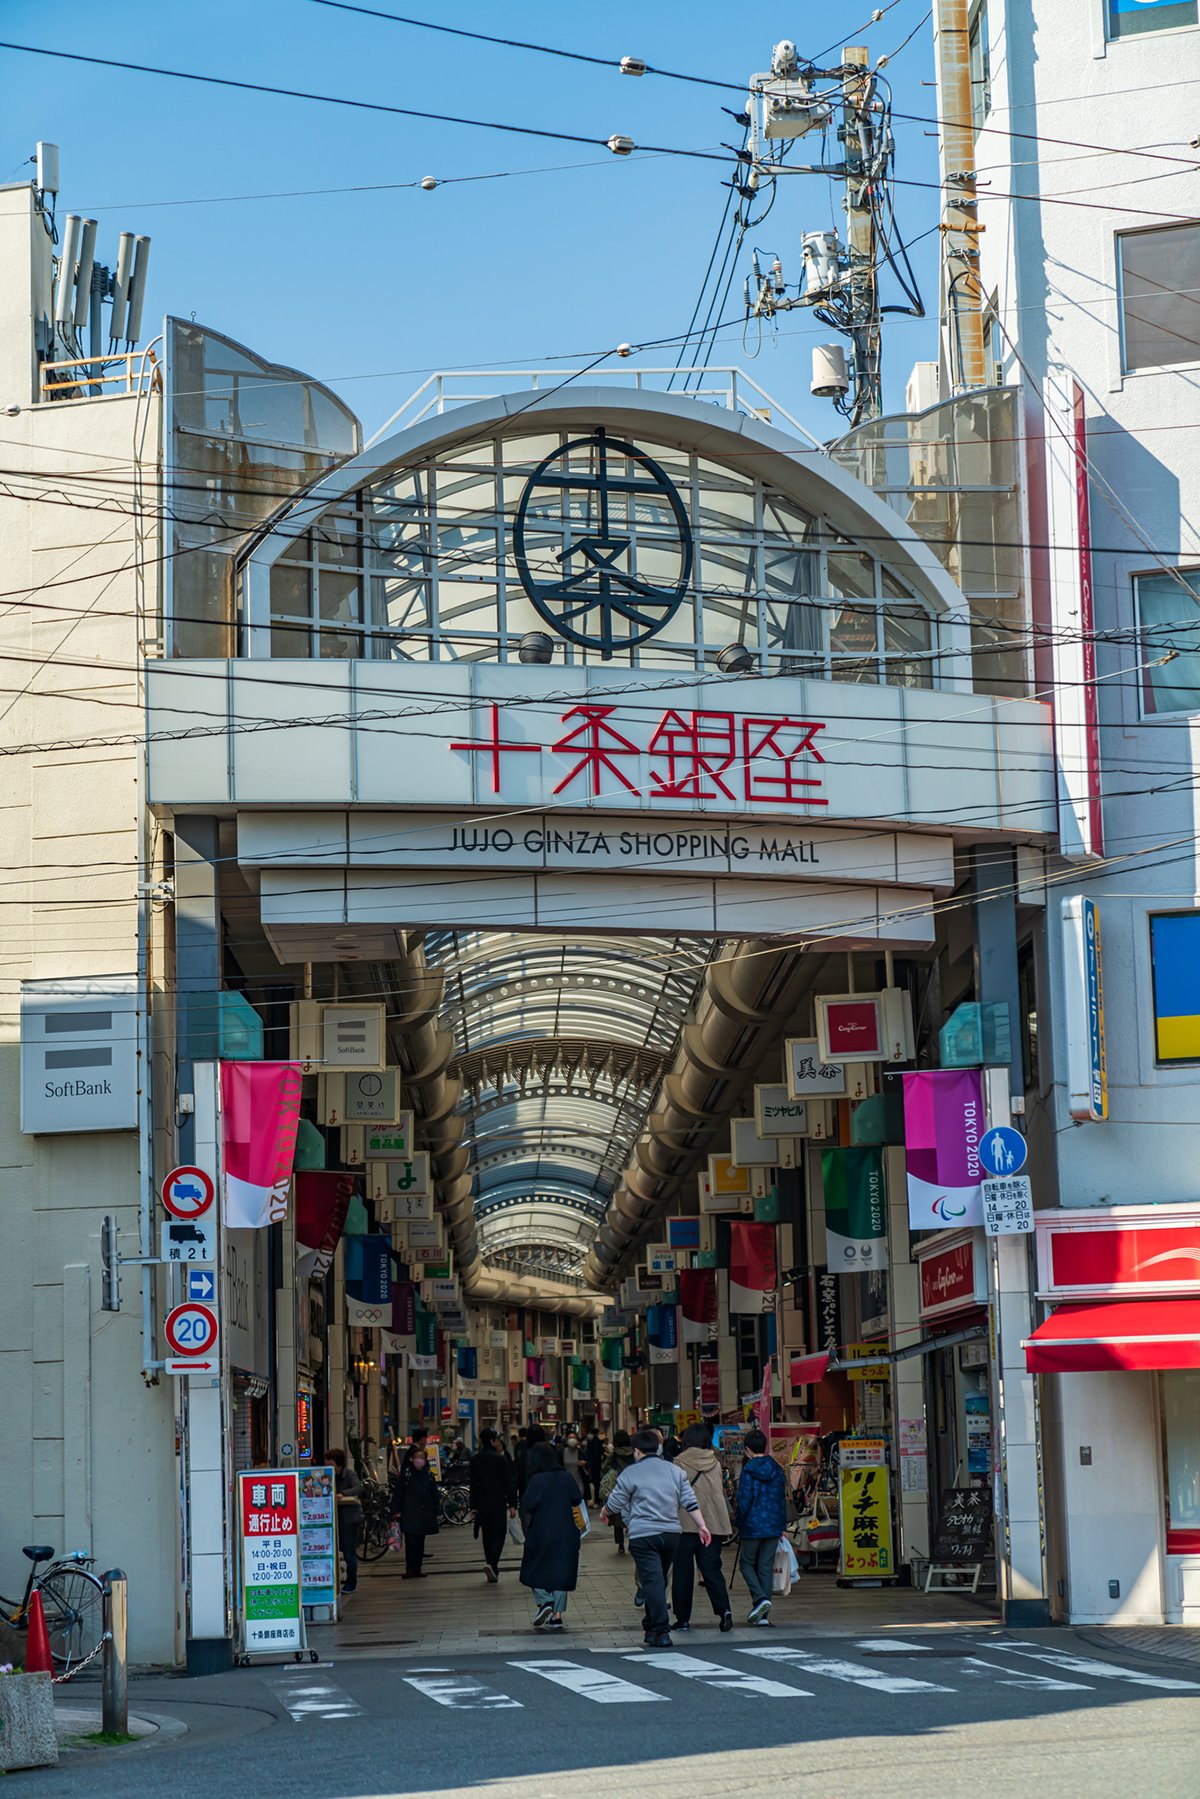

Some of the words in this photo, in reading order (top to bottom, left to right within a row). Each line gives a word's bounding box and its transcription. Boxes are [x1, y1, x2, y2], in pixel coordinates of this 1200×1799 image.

[449, 702, 829, 806] 十条銀座
[447, 827, 515, 853] JUJO
[522, 829, 612, 855] GINZA
[619, 831, 750, 860] SHOPPING
[758, 837, 820, 863] MALL
[45, 1079, 112, 1099] SoftBank
[764, 1105, 804, 1118] ミツヤビル
[963, 1100, 979, 1143] TOKYO
[965, 1145, 980, 1177] 2020
[868, 1170, 880, 1205] TOKYO
[984, 1181, 1027, 1192] 自転車を除く
[987, 1210, 1031, 1222] 日曜・休日は
[988, 1203, 997, 1212] 14
[1015, 1200, 1027, 1210] 20
[870, 1205, 882, 1232] 2020
[990, 1223, 999, 1232] 12
[1017, 1220, 1029, 1230] 20
[379, 1253, 388, 1279] TOKYO
[380, 1280, 389, 1300] 2020
[818, 1275, 838, 1353] 石窯パン工房
[177, 1318, 207, 1342] 20
[251, 1483, 288, 1510] 車両
[852, 1471, 880, 1549] リーチ麻雀
[248, 1513, 293, 1533] 通行止め
[251, 1548, 292, 1559] 14:00-20:00
[262, 1539, 282, 1548] 平日
[257, 1562, 287, 1571] 日・祝日
[845, 1552, 879, 1569] とっぷ
[252, 1570, 293, 1581] 12:00-20:00
[251, 1628, 295, 1640] 十条銀座商店街
